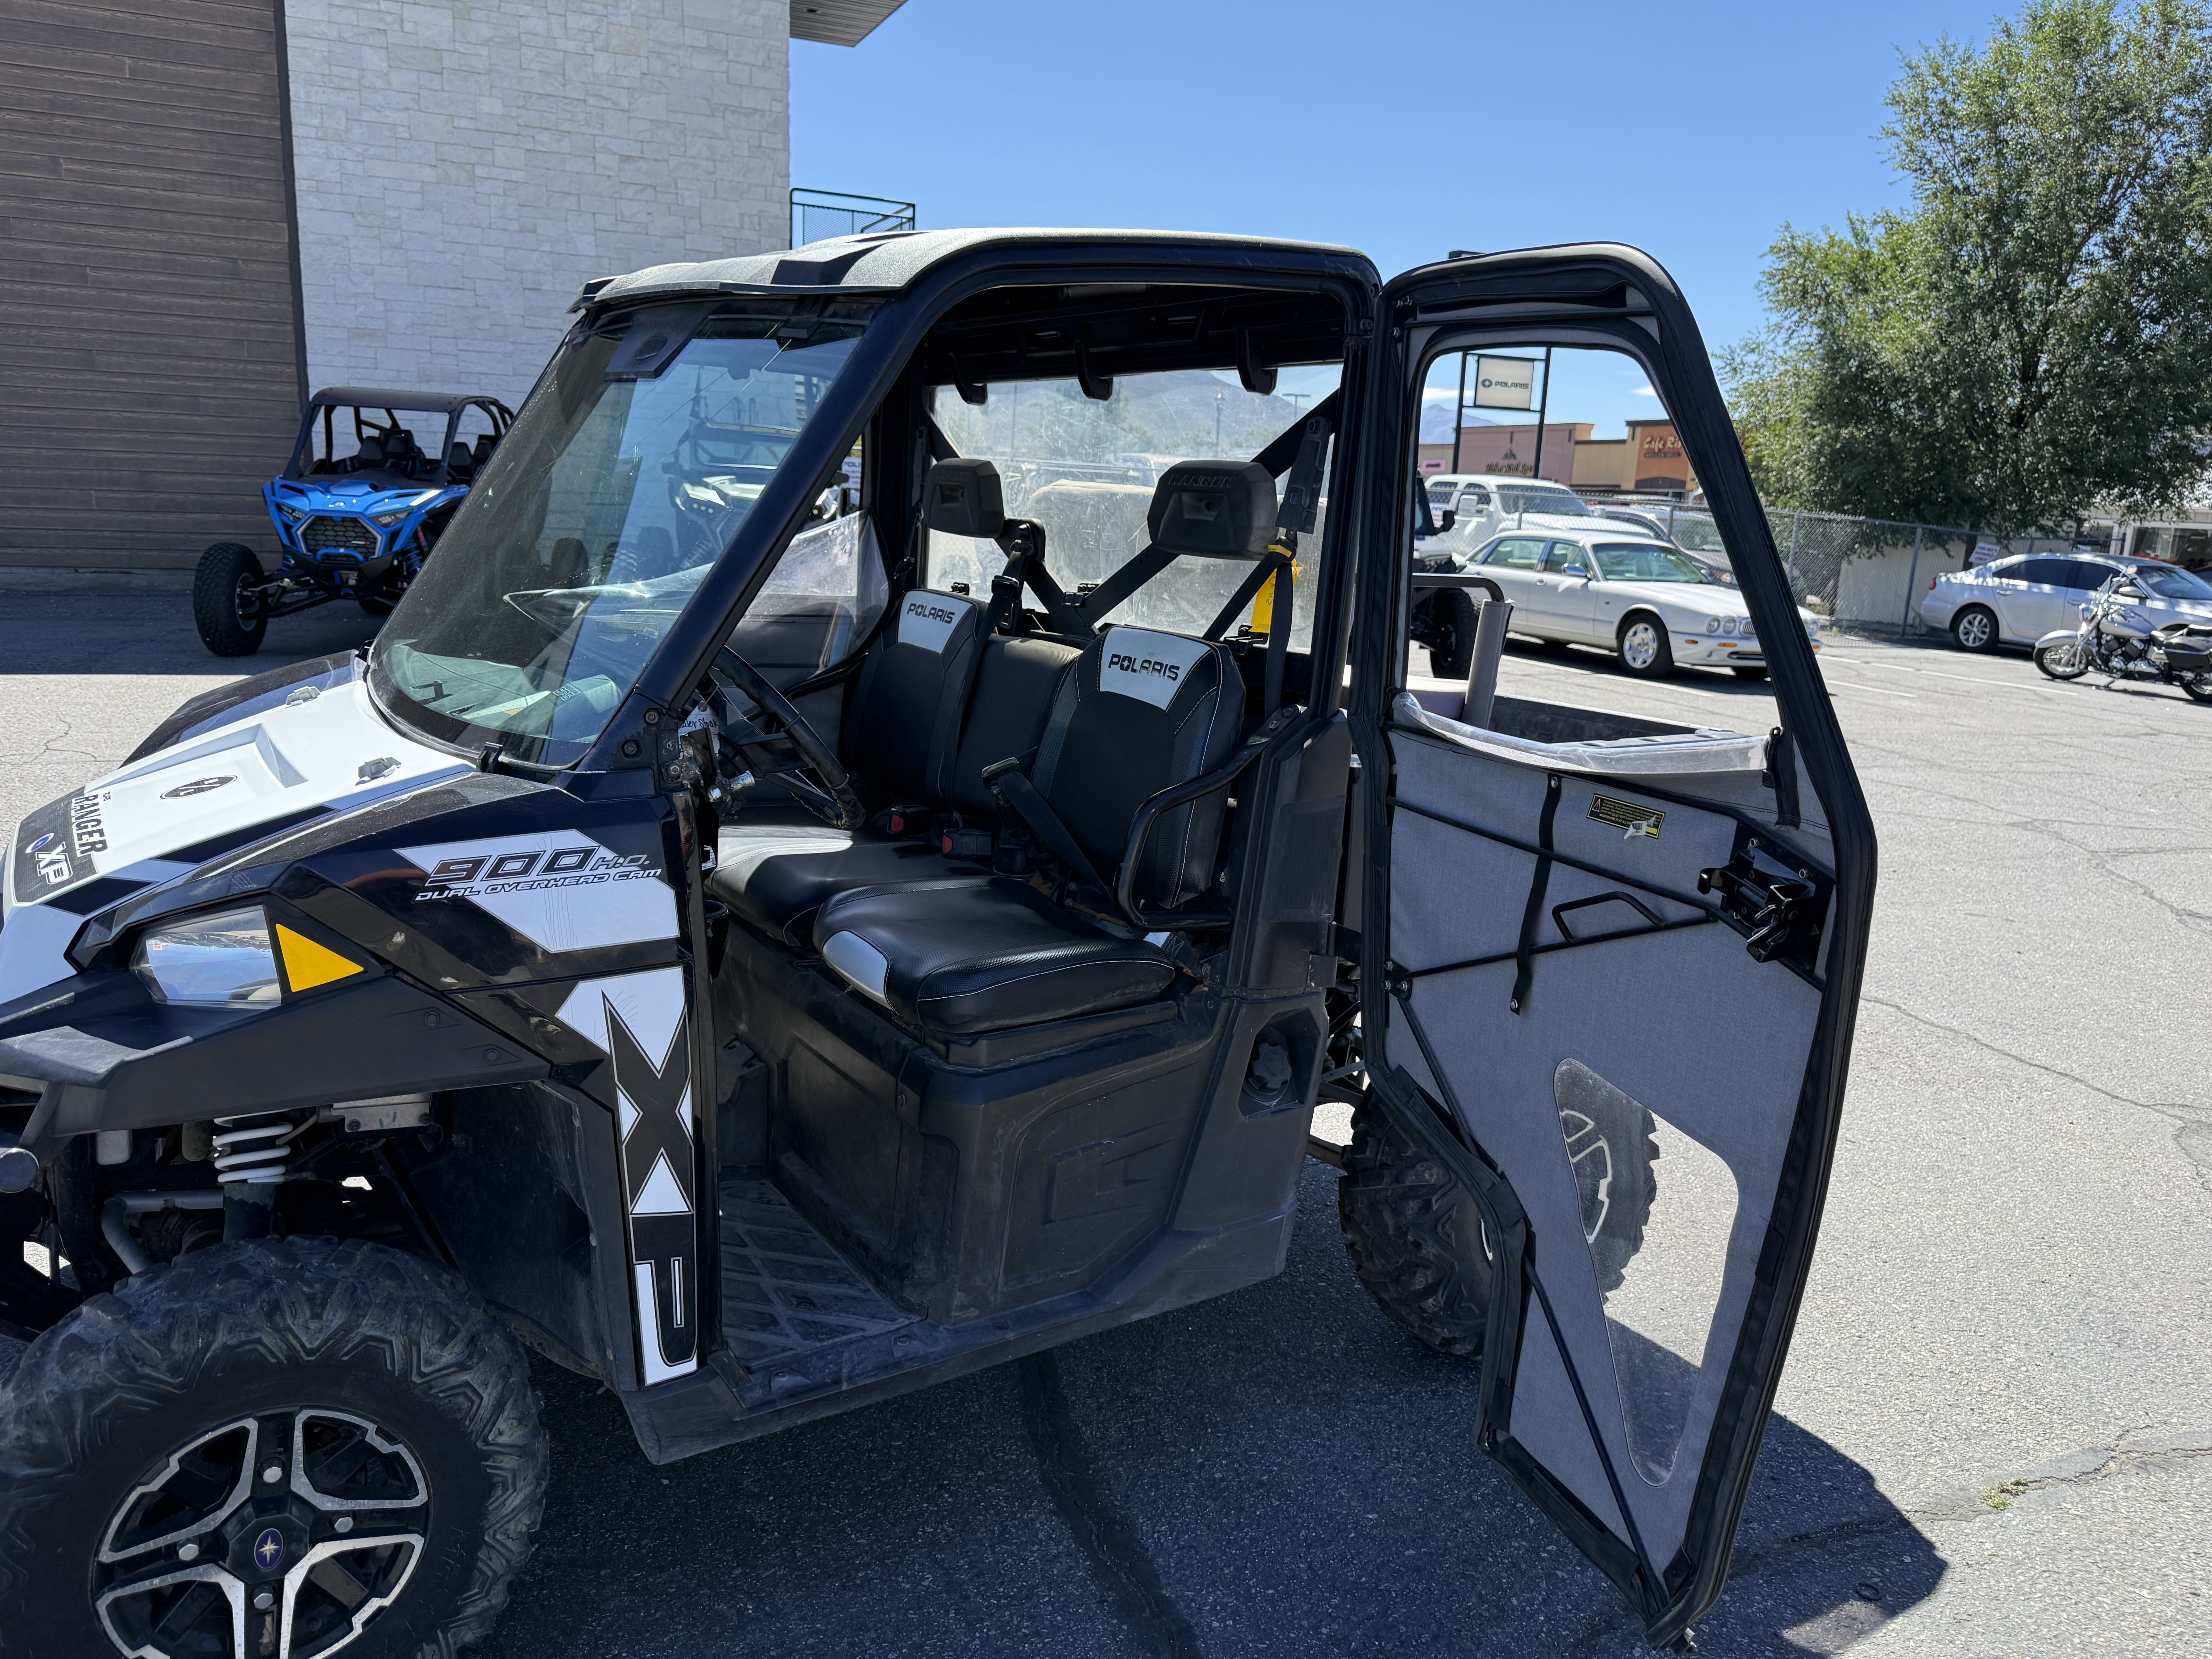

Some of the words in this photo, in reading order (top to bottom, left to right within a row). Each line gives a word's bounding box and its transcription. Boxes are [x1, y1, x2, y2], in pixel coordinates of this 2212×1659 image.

[1494, 381, 1529, 389] POLARIS
[1643, 436, 1664, 452] Cafe
[1168, 474, 1236, 488] RANGER
[907, 603, 955, 624] POLARIS
[1108, 653, 1180, 681] POLARIS
[680, 719, 697, 729] aler
[72, 794, 108, 857] RANGER
[35, 841, 73, 884] XP
[425, 846, 600, 886] 900
[415, 886, 482, 901] DUAL
[484, 873, 610, 895] OVERHEAD
[612, 869, 662, 881] CAM
[601, 989, 698, 1367] XP
